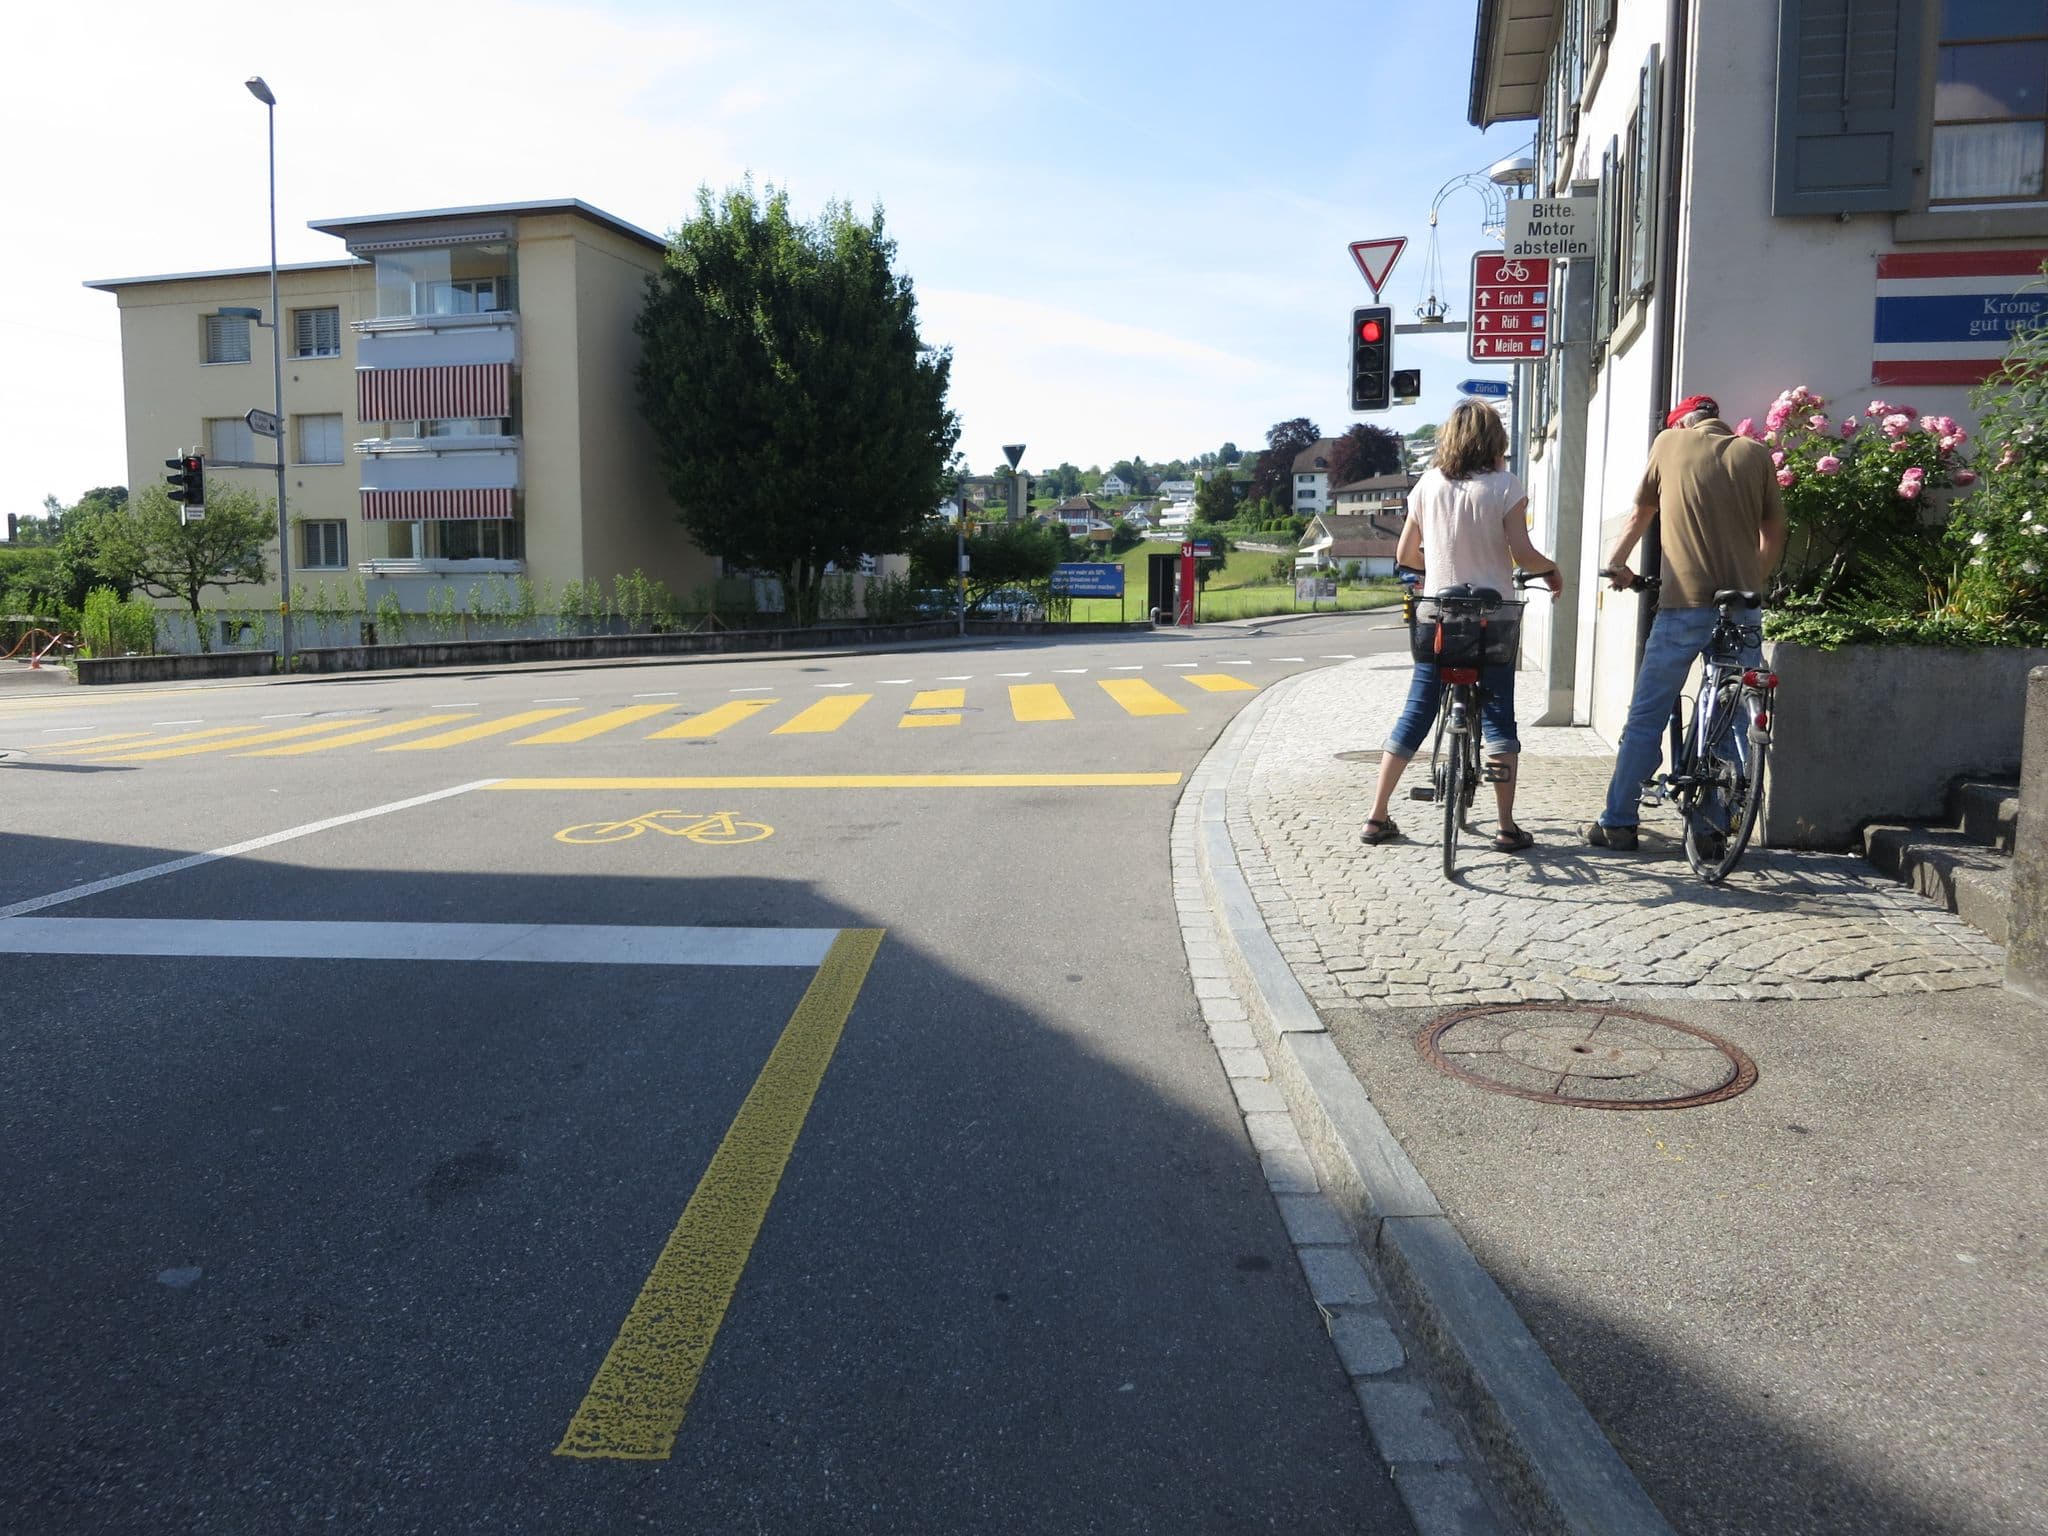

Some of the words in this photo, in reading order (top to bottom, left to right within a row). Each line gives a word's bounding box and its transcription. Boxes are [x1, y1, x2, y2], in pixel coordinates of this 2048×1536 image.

[1532, 203, 1571, 218] Bitte
[1527, 222, 1576, 236] Motor
[1513, 239, 1588, 255] abstellen
[1498, 291, 1523, 305] Forch
[1984, 298, 2040, 314] Krone
[1501, 314, 1519, 329] Rüti
[1969, 318, 1999, 335] gut
[2005, 314, 2038, 331] und
[1495, 338, 1523, 353] Meilen
[1474, 383, 1498, 393] Zürich
